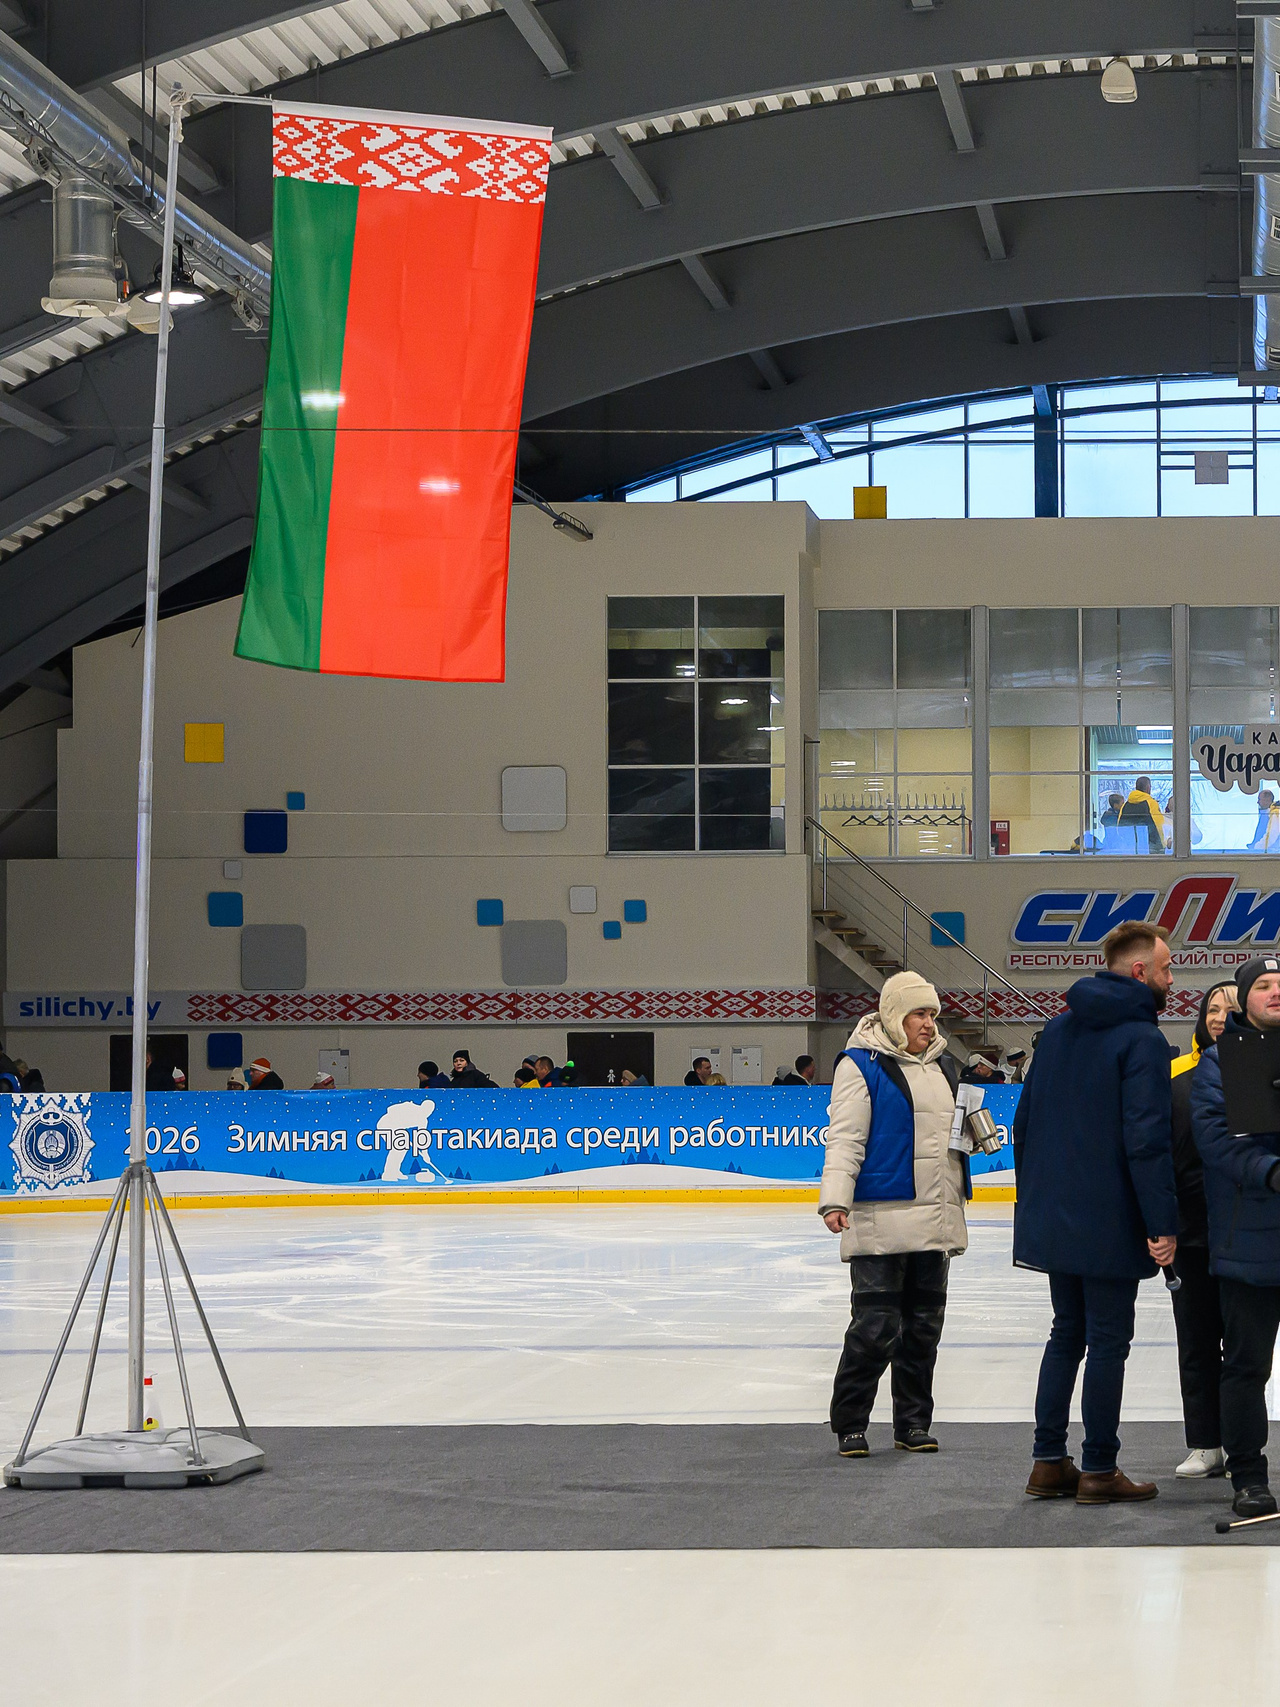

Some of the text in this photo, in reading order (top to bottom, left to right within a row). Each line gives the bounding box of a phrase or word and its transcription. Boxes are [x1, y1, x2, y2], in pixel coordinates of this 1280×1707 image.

[227, 1124, 348, 1153] Зимняя
[356, 1124, 558, 1157] спартакиада
[566, 1125, 660, 1155] среди
